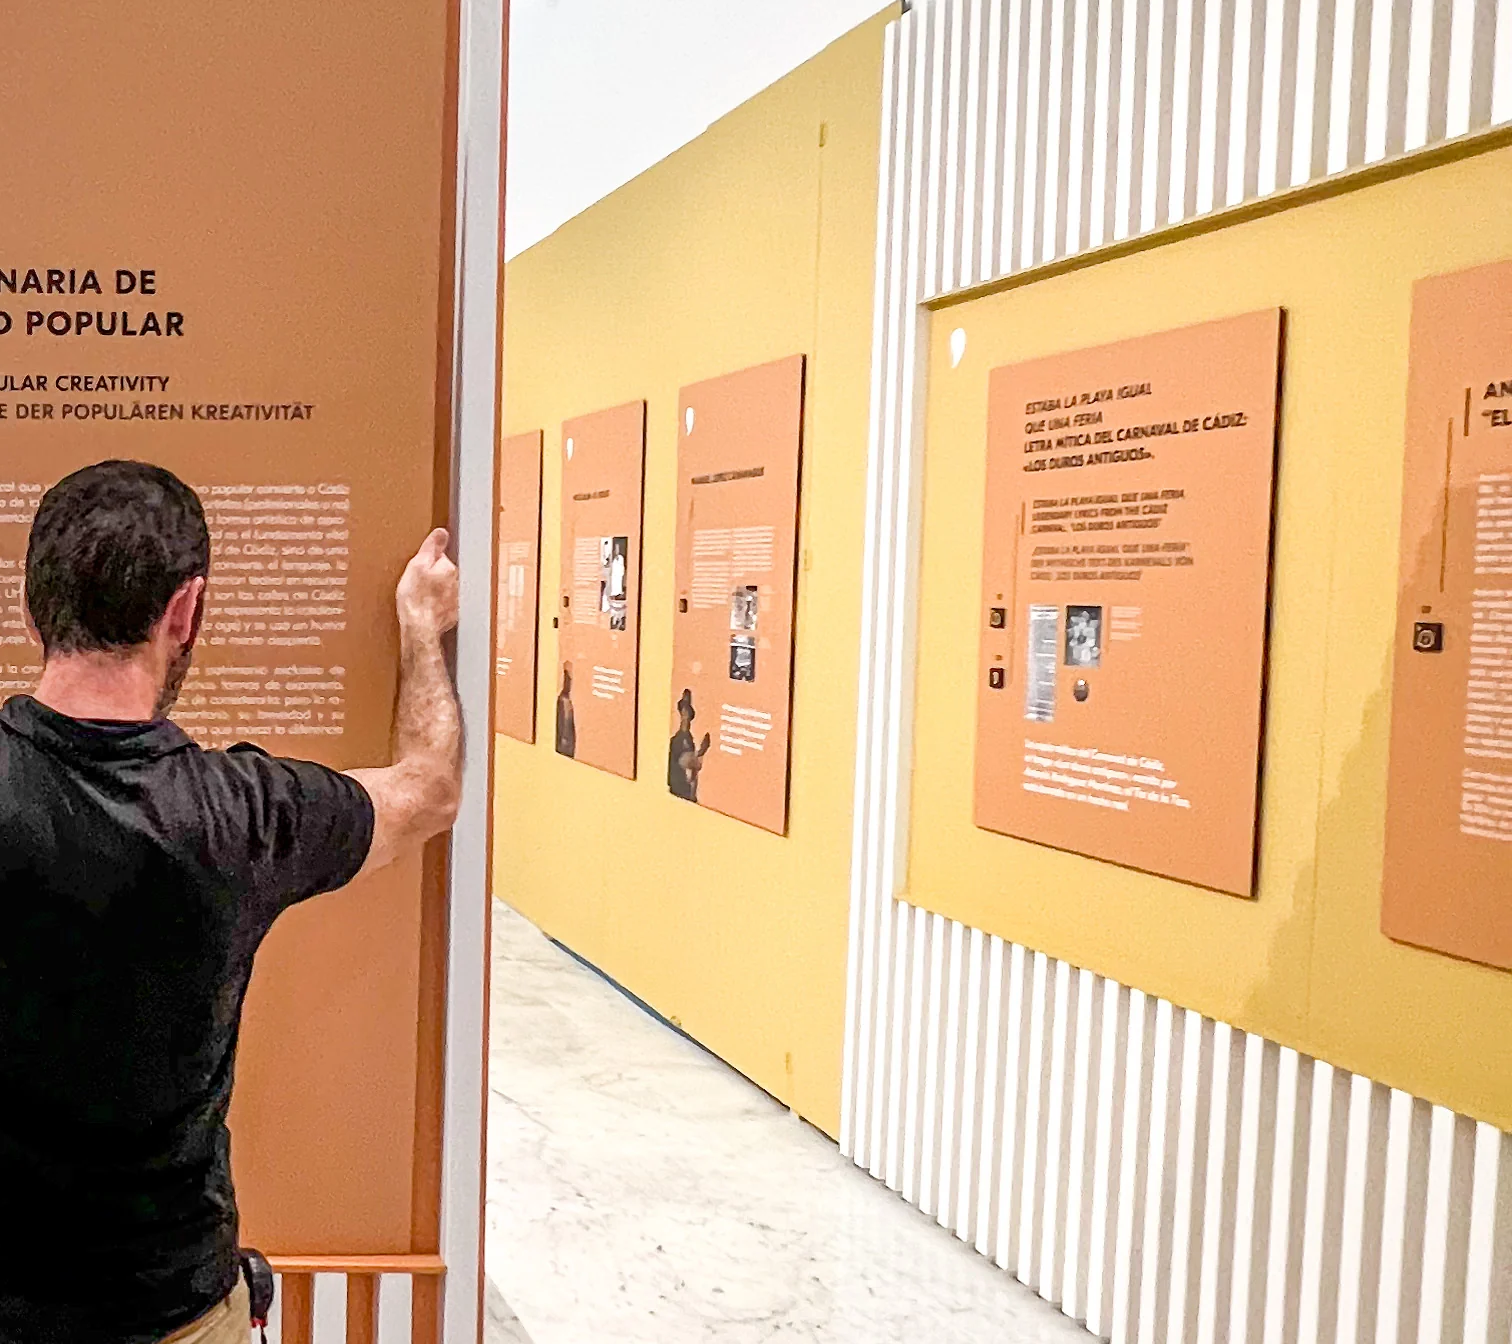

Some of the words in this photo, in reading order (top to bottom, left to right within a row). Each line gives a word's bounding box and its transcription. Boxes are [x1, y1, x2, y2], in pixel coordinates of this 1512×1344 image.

[115, 269, 157, 294] DE
[26, 311, 185, 336] POPULAR
[55, 375, 170, 392] CREATIVITY
[15, 403, 55, 420] DER
[61, 400, 184, 421] POPULÄREN
[191, 400, 314, 421] KREATIVITÄT
[1025, 399, 1061, 414] ESTABA
[1064, 396, 1077, 408] LA
[1080, 388, 1113, 404] PLAYA
[1117, 383, 1152, 400] IGUAL
[1117, 421, 1179, 441] CARNAVAL
[1182, 418, 1199, 433] DE
